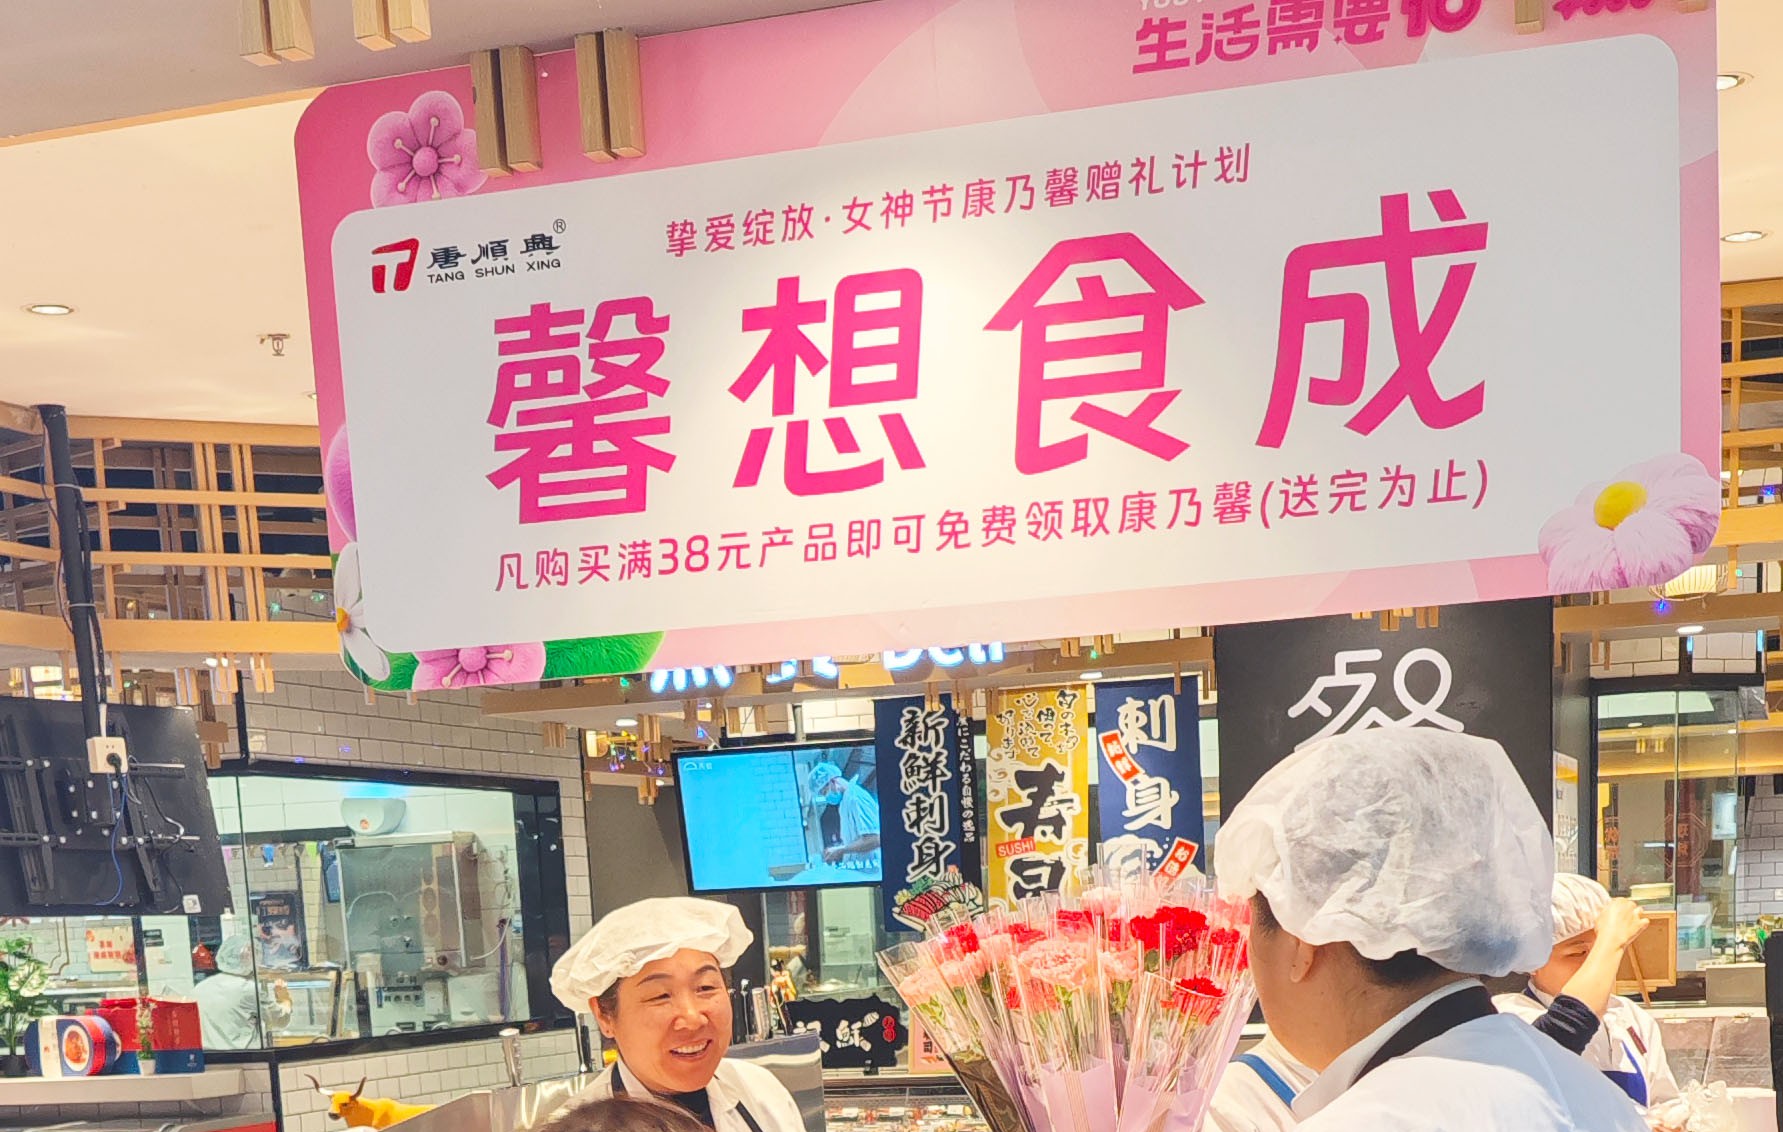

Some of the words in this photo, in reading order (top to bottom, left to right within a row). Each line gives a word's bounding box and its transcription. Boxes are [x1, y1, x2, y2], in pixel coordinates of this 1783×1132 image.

[664, 142, 1252, 258] 挚爱绽放·女神节康乃馨赠礼计划
[427, 270, 465, 284] TANG
[474, 263, 516, 278] SHUN
[526, 257, 561, 272] XING
[486, 189, 1490, 524] 馨想食成
[494, 458, 1490, 592] 凡购买满38元产品即可免费领取康乃馨(送完为止)
[998, 841, 1034, 857] SUSHI
